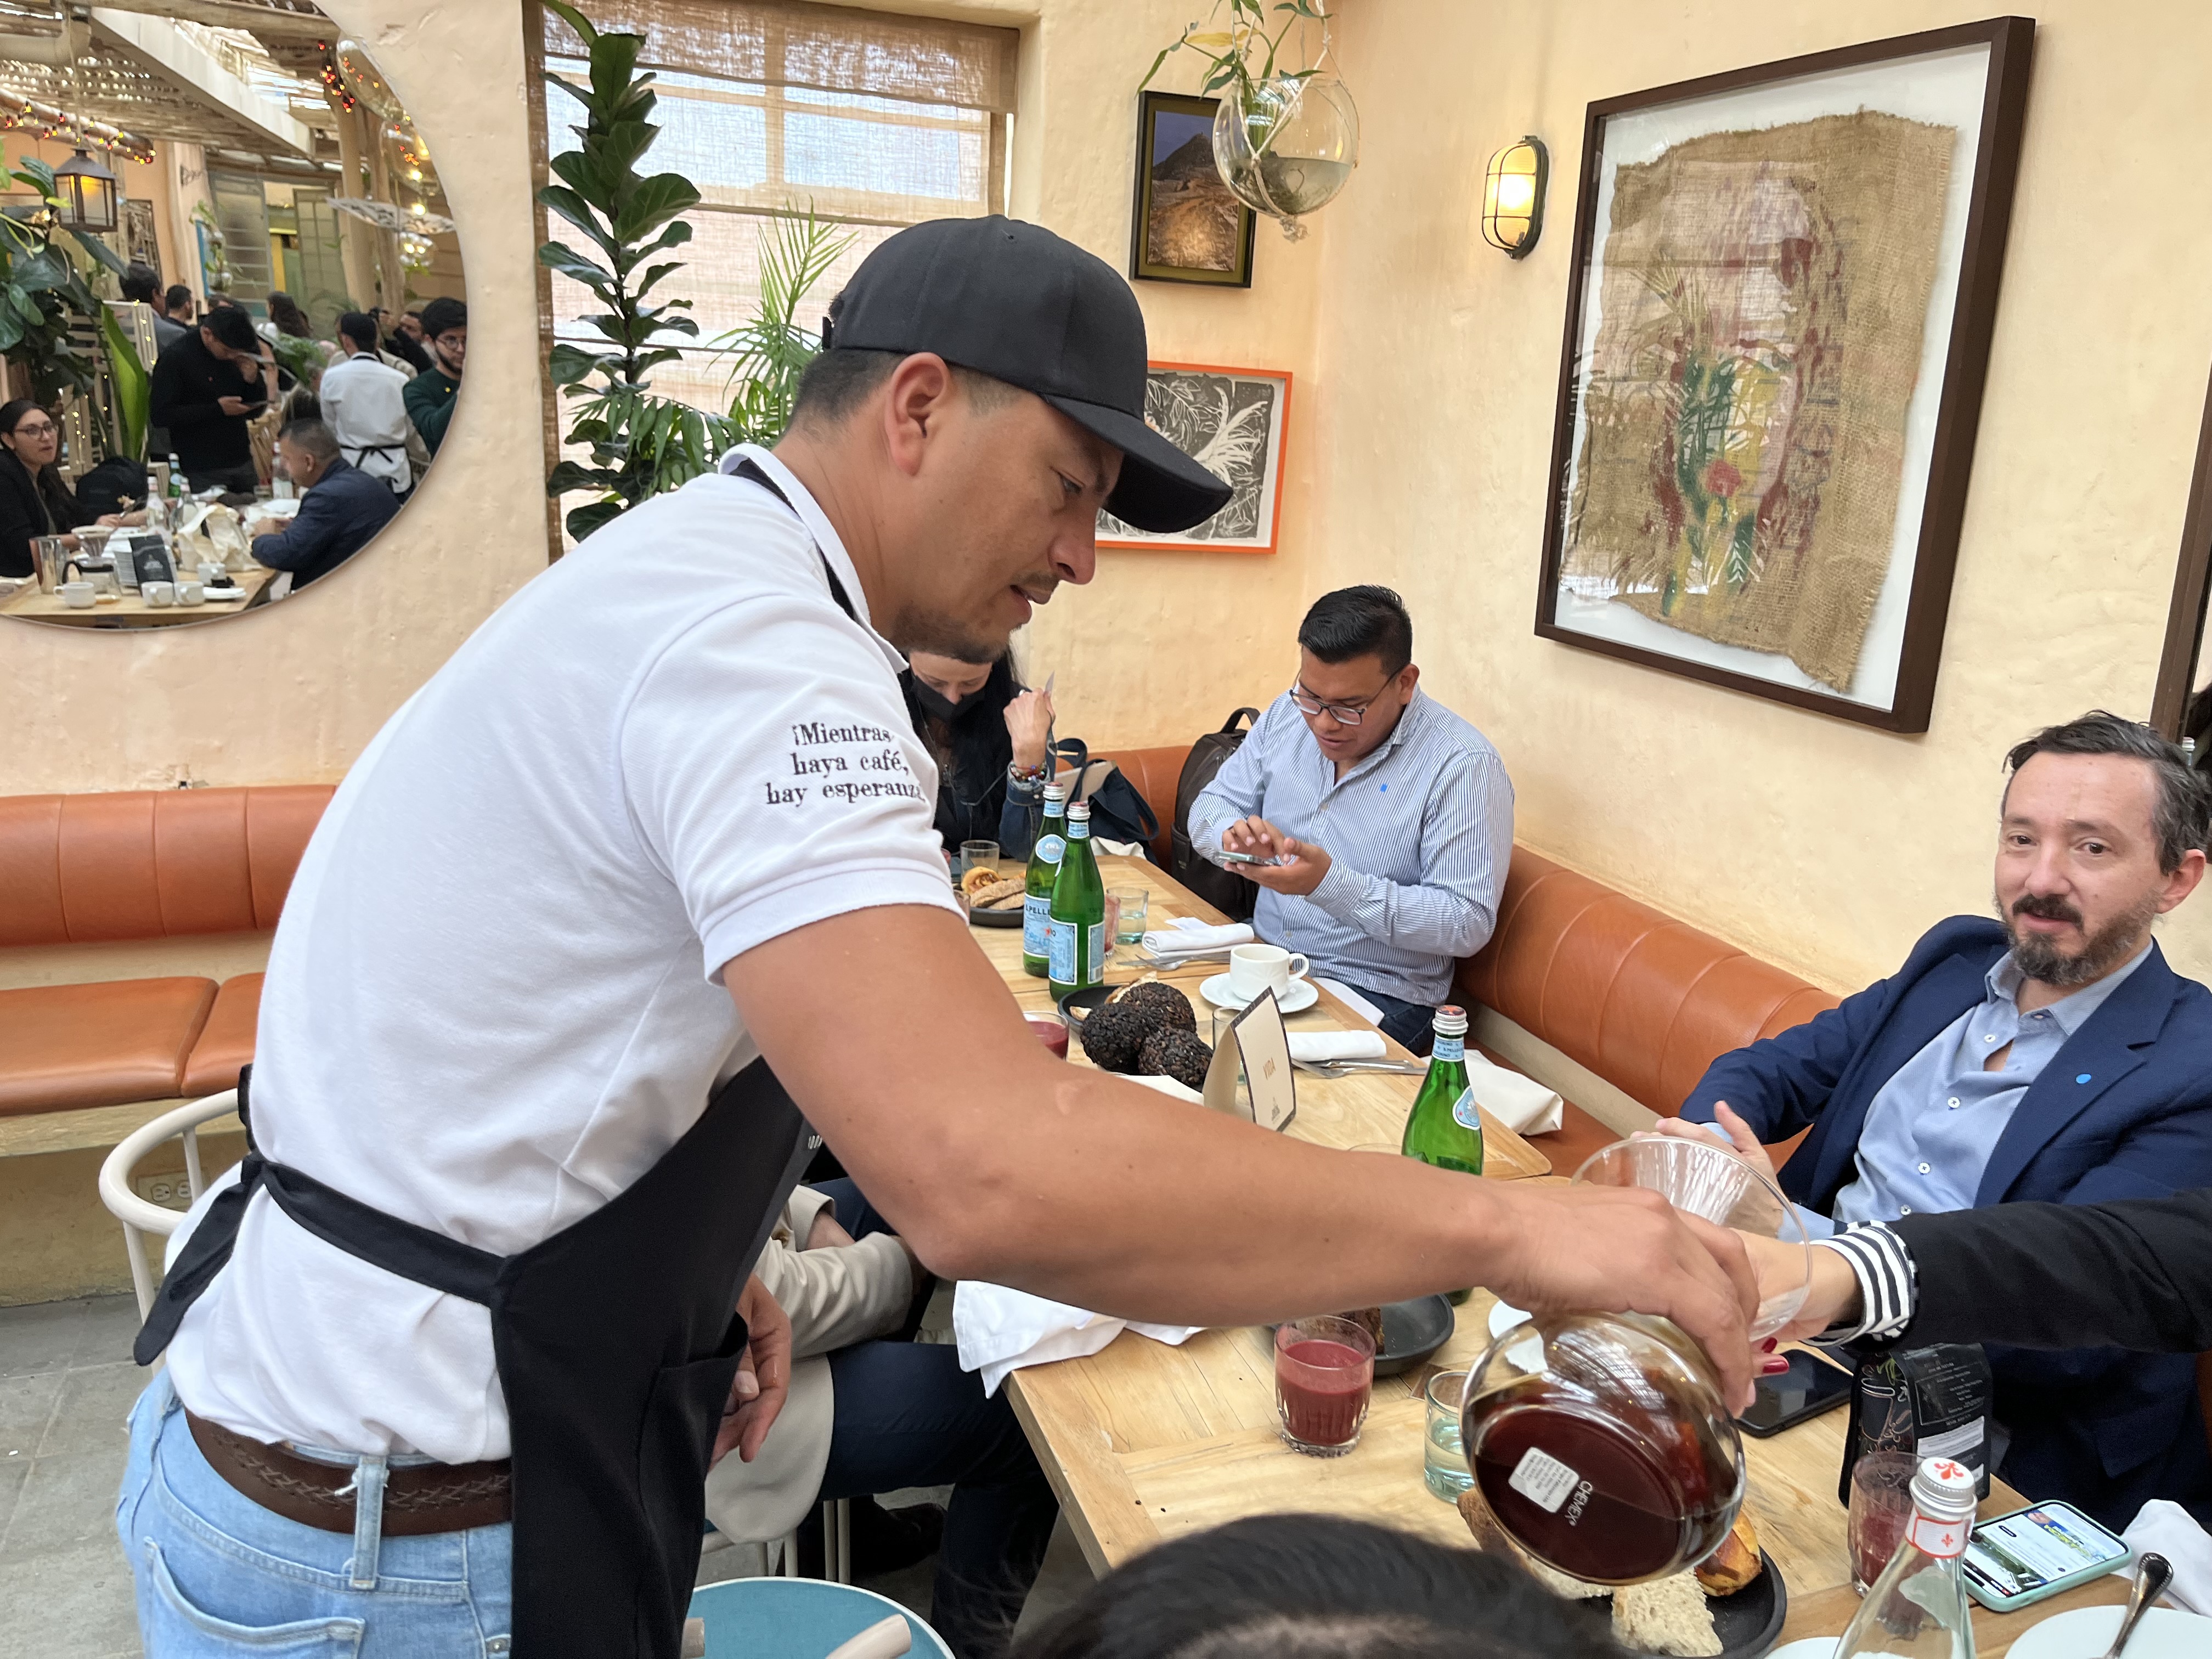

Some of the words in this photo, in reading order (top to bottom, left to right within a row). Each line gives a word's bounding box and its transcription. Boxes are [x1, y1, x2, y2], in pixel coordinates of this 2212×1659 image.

[790, 752, 848, 778] haya
[860, 749, 909, 775] café,
[765, 782, 808, 807] hay
